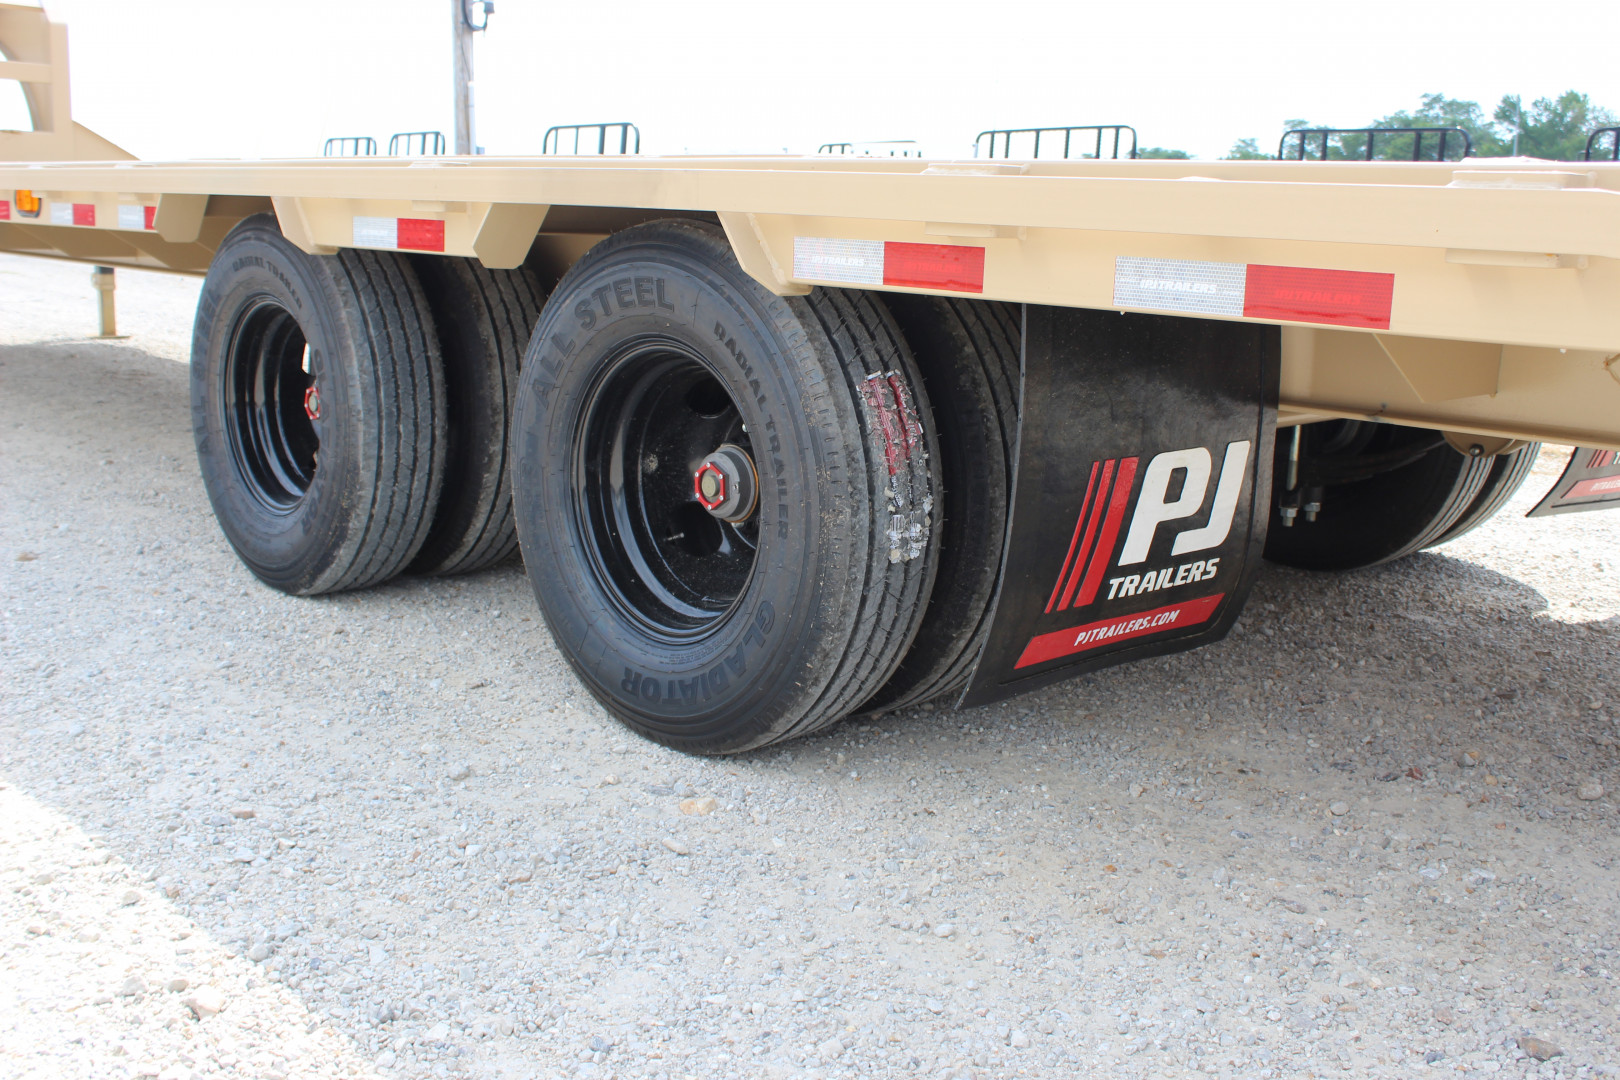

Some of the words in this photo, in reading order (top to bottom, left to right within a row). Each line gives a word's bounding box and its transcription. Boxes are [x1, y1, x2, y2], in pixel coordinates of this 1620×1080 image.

[530, 332, 576, 411] ALL
[574, 276, 675, 332] STEEL
[713, 320, 767, 412] RADIAL
[764, 413, 790, 541] TRAILER
[1118, 440, 1251, 567] PJ
[1074, 609, 1181, 647] PJTRAILERS.COM
[1107, 557, 1221, 600] TRAILERS
[620, 600, 776, 706] GLADIATOR
